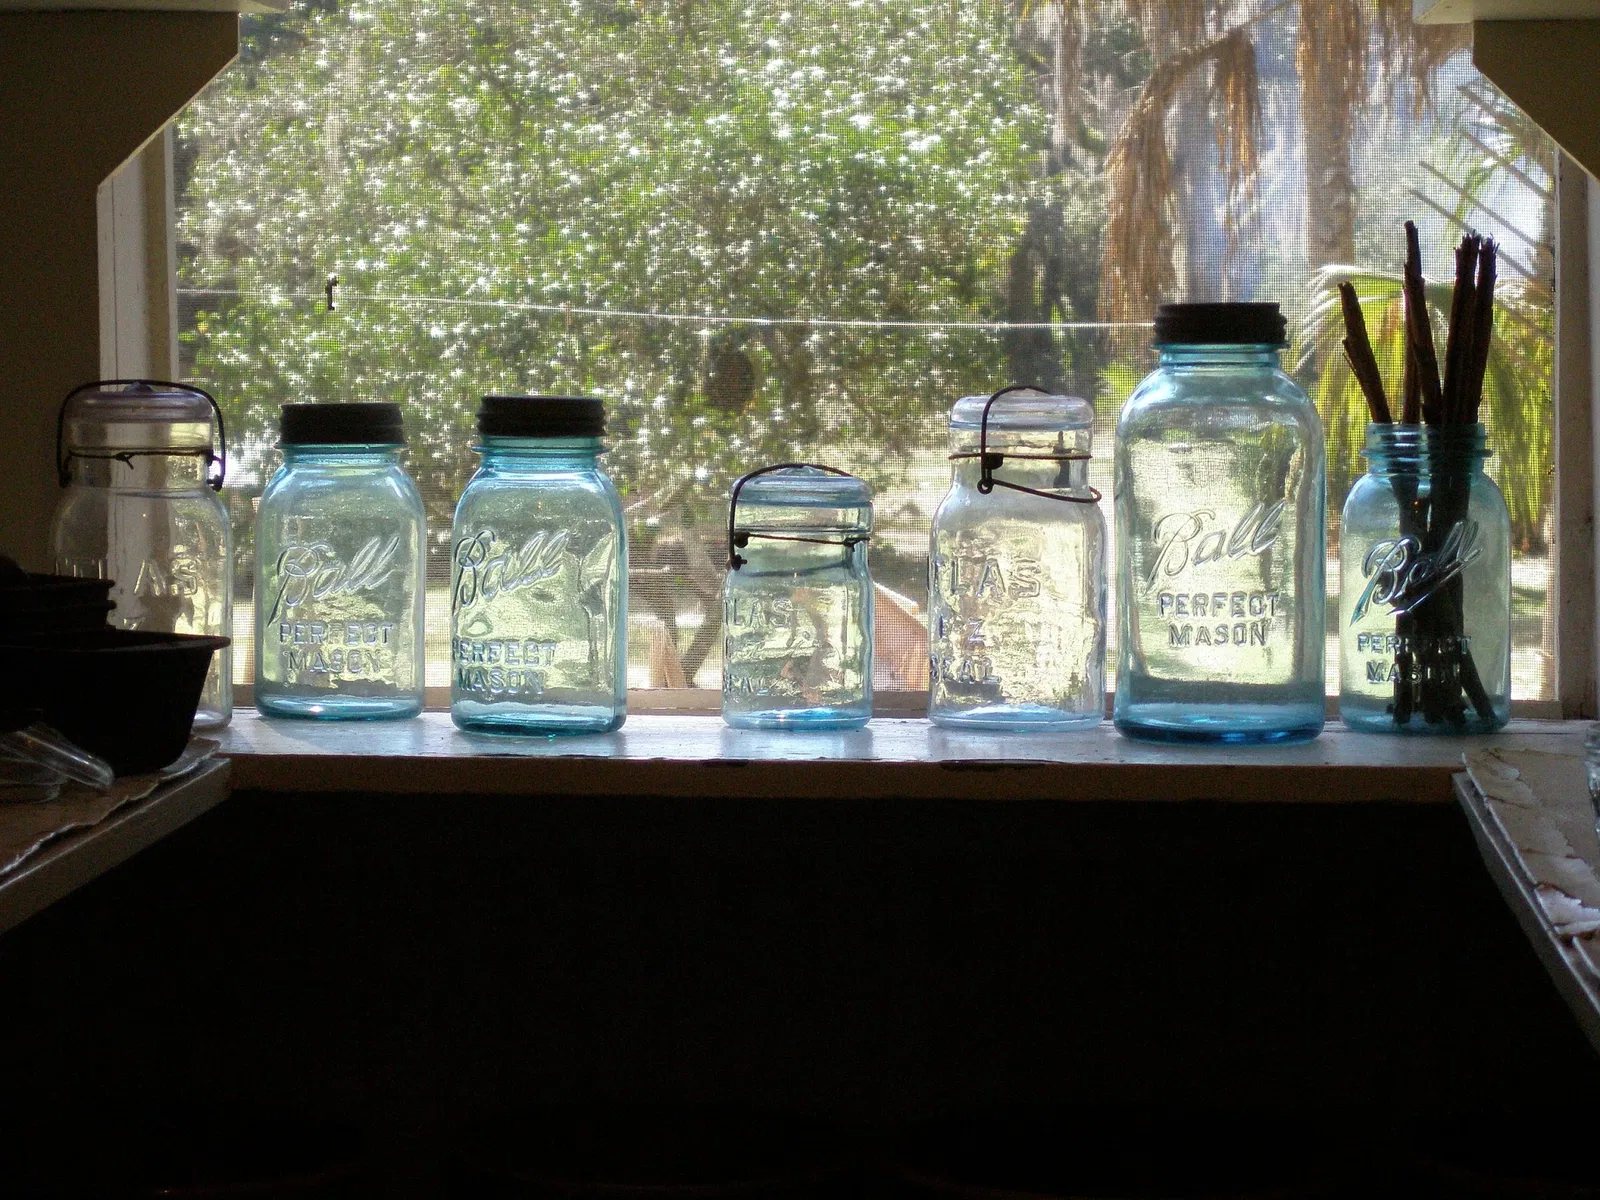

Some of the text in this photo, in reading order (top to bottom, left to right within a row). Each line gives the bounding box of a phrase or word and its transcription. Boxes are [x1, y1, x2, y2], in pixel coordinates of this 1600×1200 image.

[267, 535, 400, 628] Ball
[452, 529, 570, 617] Ball
[1142, 500, 1288, 597] Ball
[1349, 519, 1483, 628] Ball
[279, 621, 394, 646] PERFECT
[1157, 591, 1281, 618] PERFECT
[1166, 621, 1272, 647] MASON
